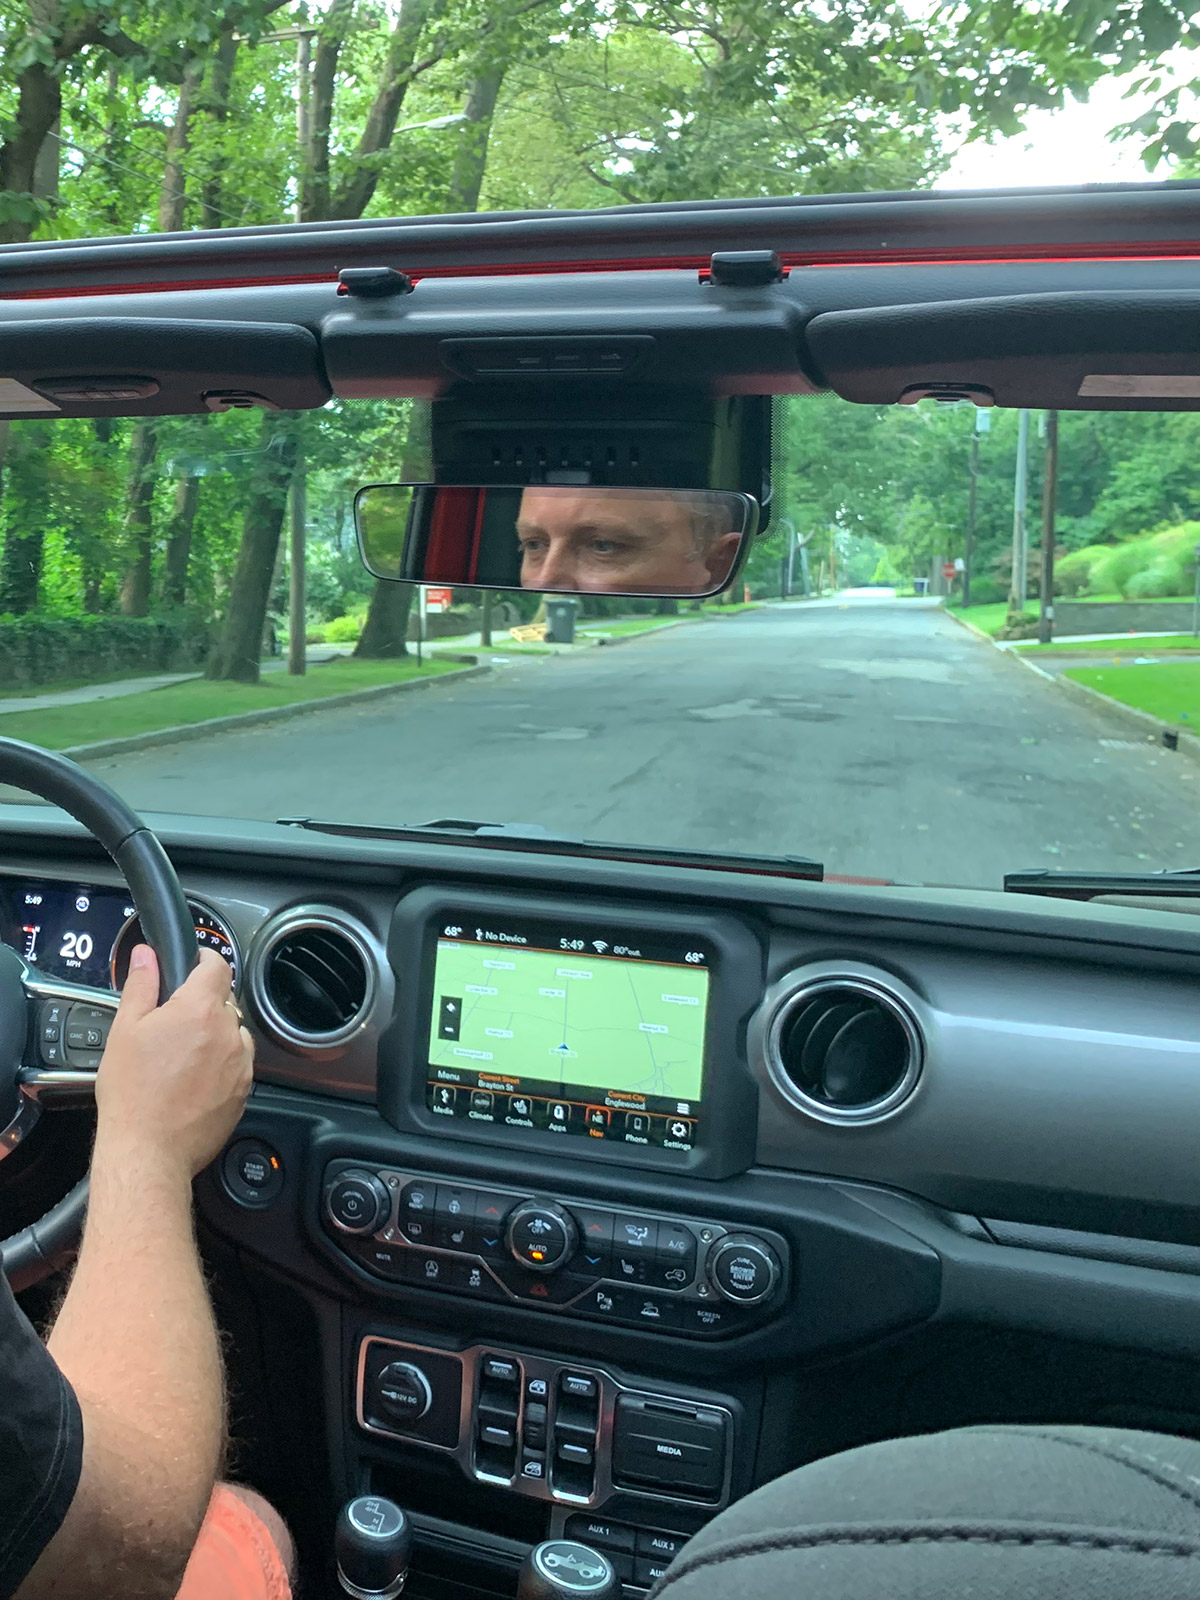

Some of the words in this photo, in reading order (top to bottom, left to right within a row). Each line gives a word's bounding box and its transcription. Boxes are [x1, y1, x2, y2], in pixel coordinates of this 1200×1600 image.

[24, 894, 42, 905] 5:49
[211, 936, 220, 944] 70
[485, 931, 498, 941] No
[499, 933, 527, 944] Device
[60, 932, 93, 960] 20
[559, 938, 585, 950] 5:49
[221, 946, 232, 955] 80
[684, 951, 705, 963] 68°
[66, 959, 81, 968] MPH
[437, 1070, 460, 1081] Menu
[478, 1079, 505, 1091] Brayton
[505, 1083, 514, 1092] St
[604, 1097, 646, 1111] Englewood
[433, 1105, 454, 1115] Media
[468, 1111, 494, 1121] Climate
[505, 1116, 533, 1128] Controls
[548, 1122, 567, 1133] Apps
[589, 1128, 604, 1138] Nav
[625, 1133, 648, 1144] Phone
[663, 1139, 692, 1151] Settings
[531, 1226, 544, 1235] OFF
[528, 1243, 547, 1252] AUTO
[668, 1240, 685, 1250] A/C
[469, 1278, 480, 1287] OFF
[697, 1310, 721, 1320] SCREEN
[702, 1316, 715, 1324] OFF
[491, 1366, 509, 1375] AUTO
[569, 1382, 588, 1392] AUTO
[657, 1444, 682, 1457] MEDIA
[588, 1523, 605, 1534] AUX
[652, 1538, 668, 1549] AUX
[668, 1542, 675, 1551] 3
